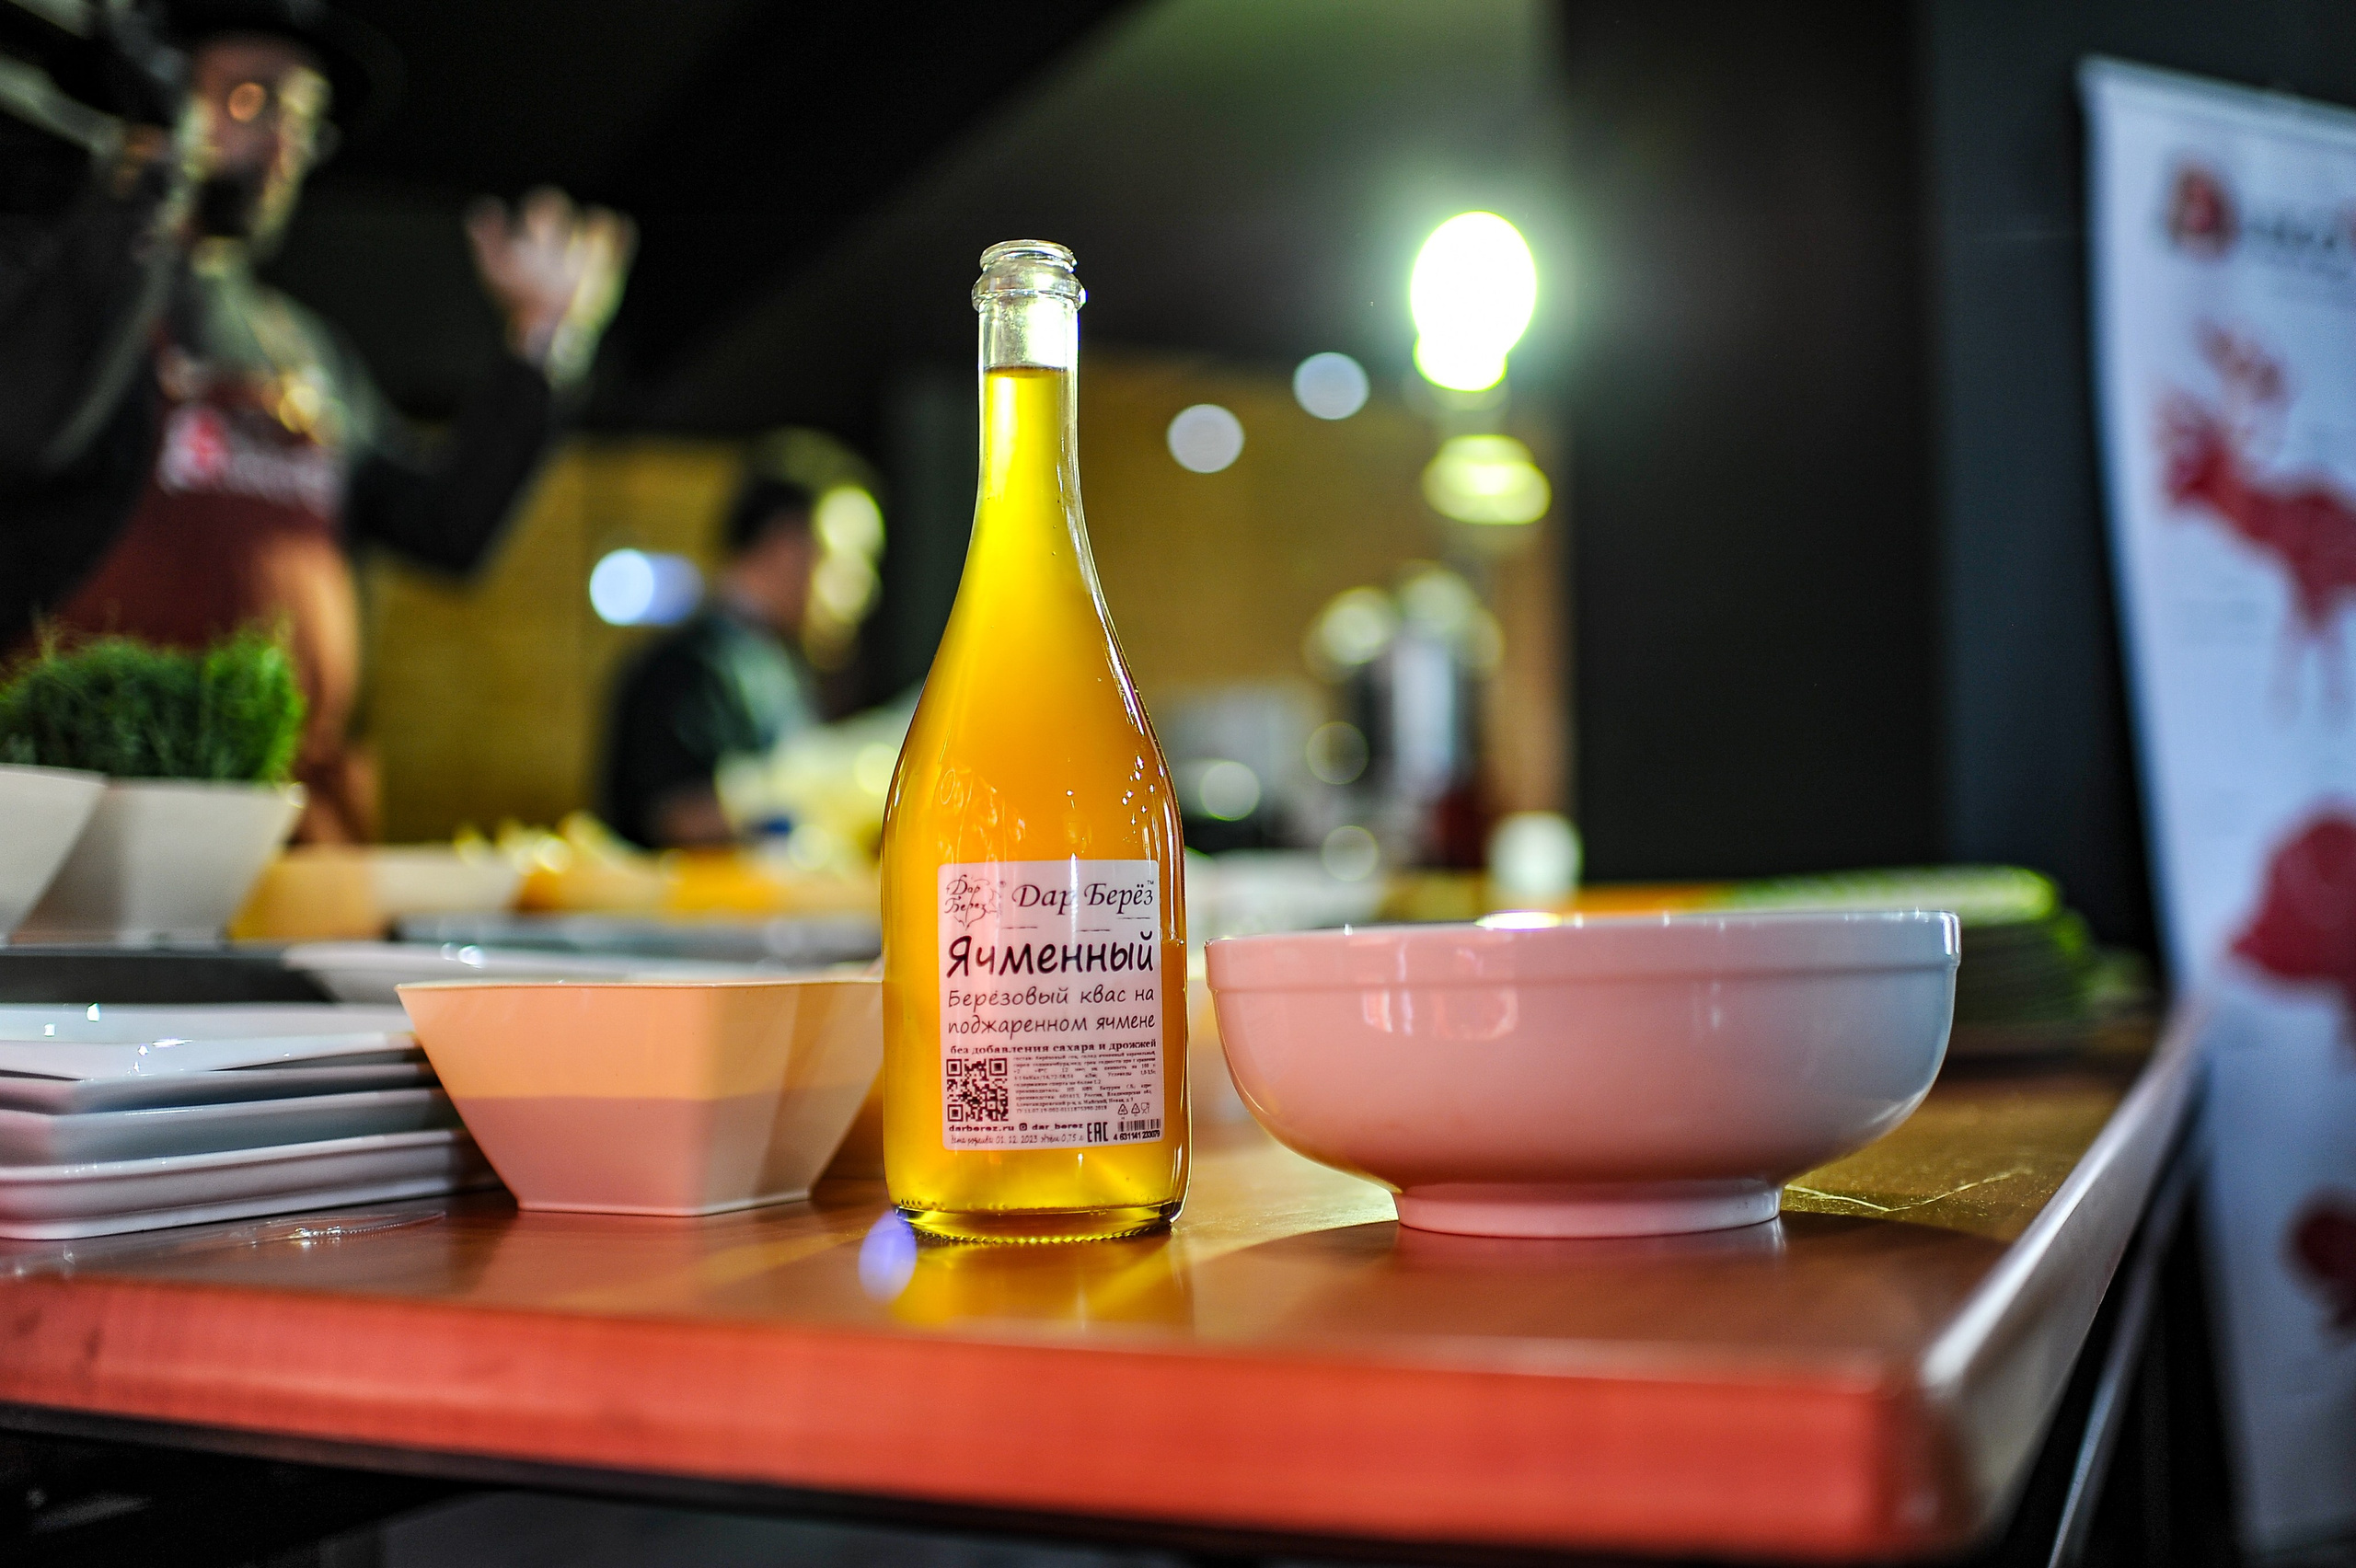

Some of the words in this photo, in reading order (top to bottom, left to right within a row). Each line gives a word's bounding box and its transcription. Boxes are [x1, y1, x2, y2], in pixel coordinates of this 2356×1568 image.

[1011, 883, 1075, 916] Дар
[1084, 882, 1153, 915] Берёз
[946, 930, 1153, 978] Ячменный
[948, 986, 1068, 1013] Берёзовый
[1080, 984, 1126, 1004] квас
[1135, 988, 1154, 1002] на
[948, 1015, 1087, 1041] поджаренном
[1096, 1014, 1156, 1031] ячмене
[950, 1044, 969, 1054] без
[971, 1043, 1050, 1055] добавления
[1053, 1043, 1095, 1054] сахара
[1098, 1043, 1106, 1051] и
[1108, 1039, 1157, 1052] дрожжей
